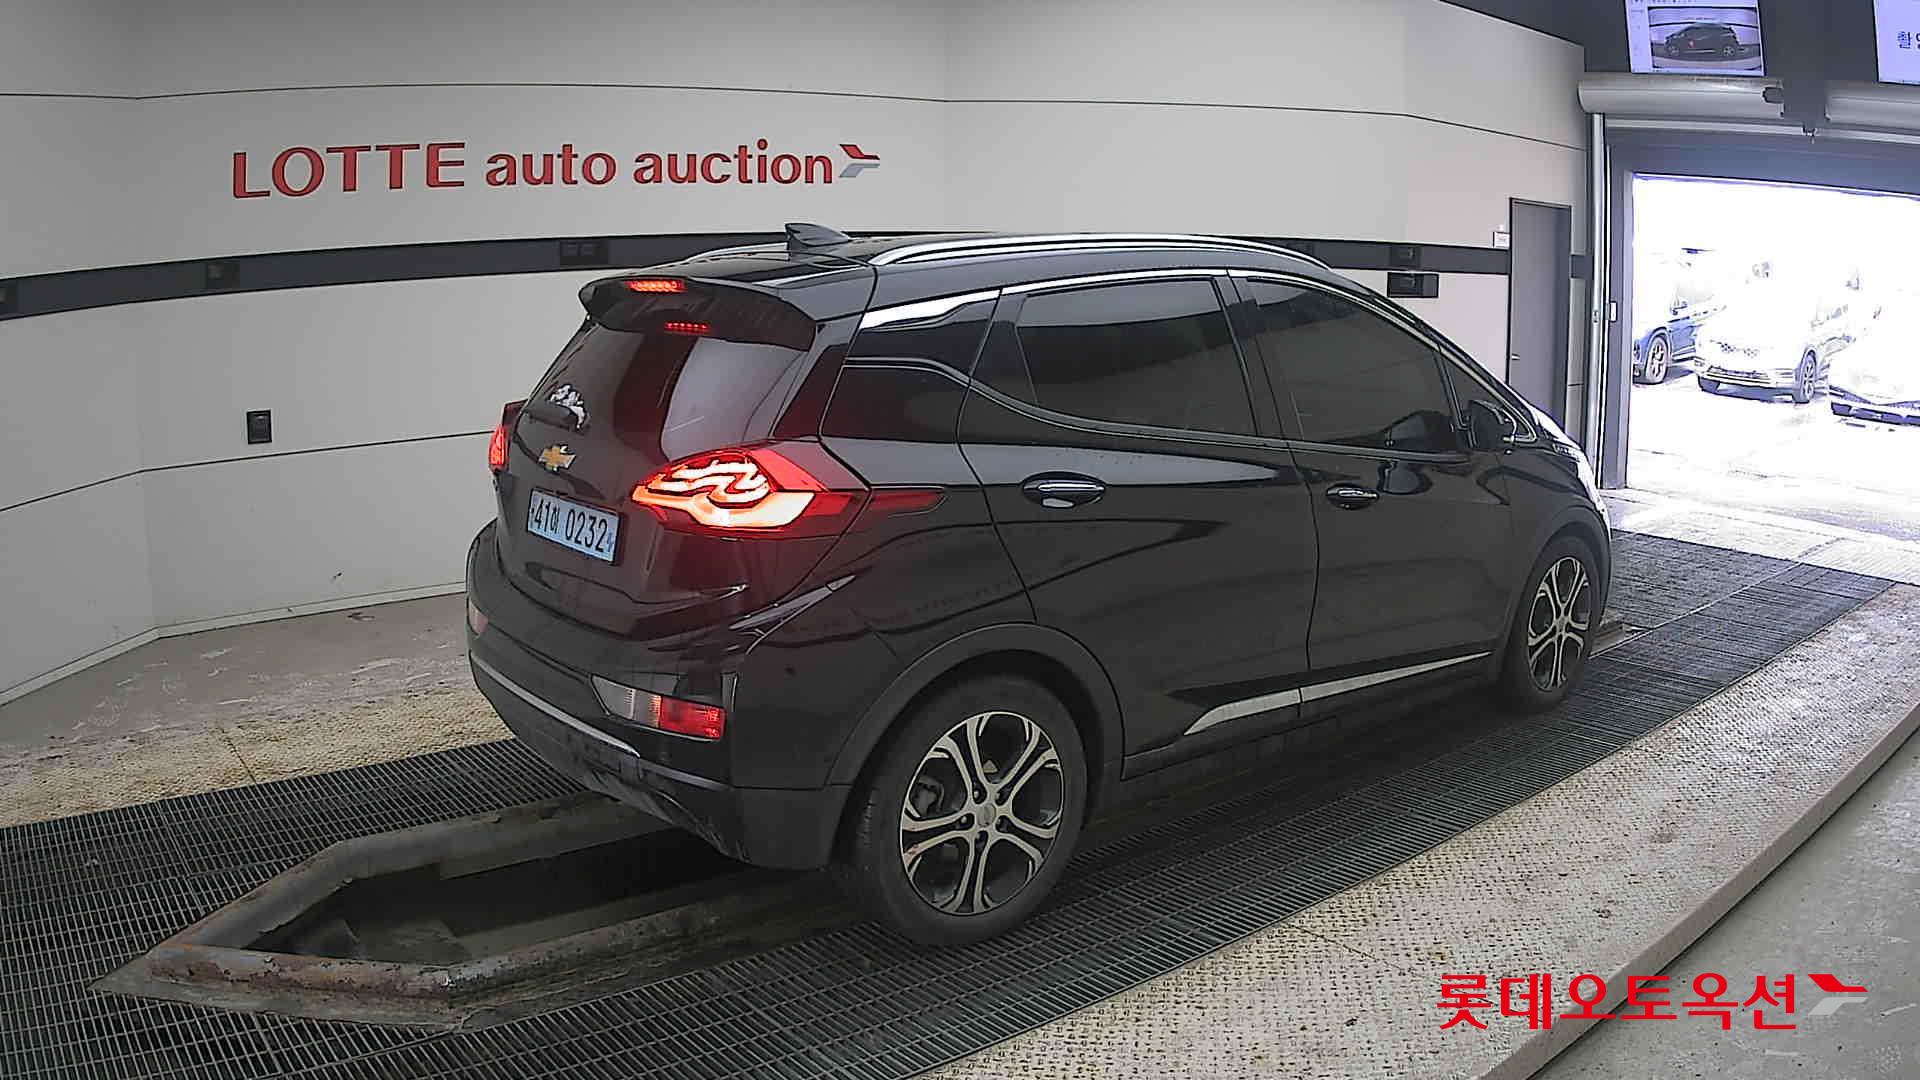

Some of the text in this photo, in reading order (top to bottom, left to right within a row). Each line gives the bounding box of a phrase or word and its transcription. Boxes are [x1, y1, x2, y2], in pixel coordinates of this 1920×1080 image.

[232, 139, 834, 199] LOTTE auto auction
[565, 508, 608, 553] 0232
